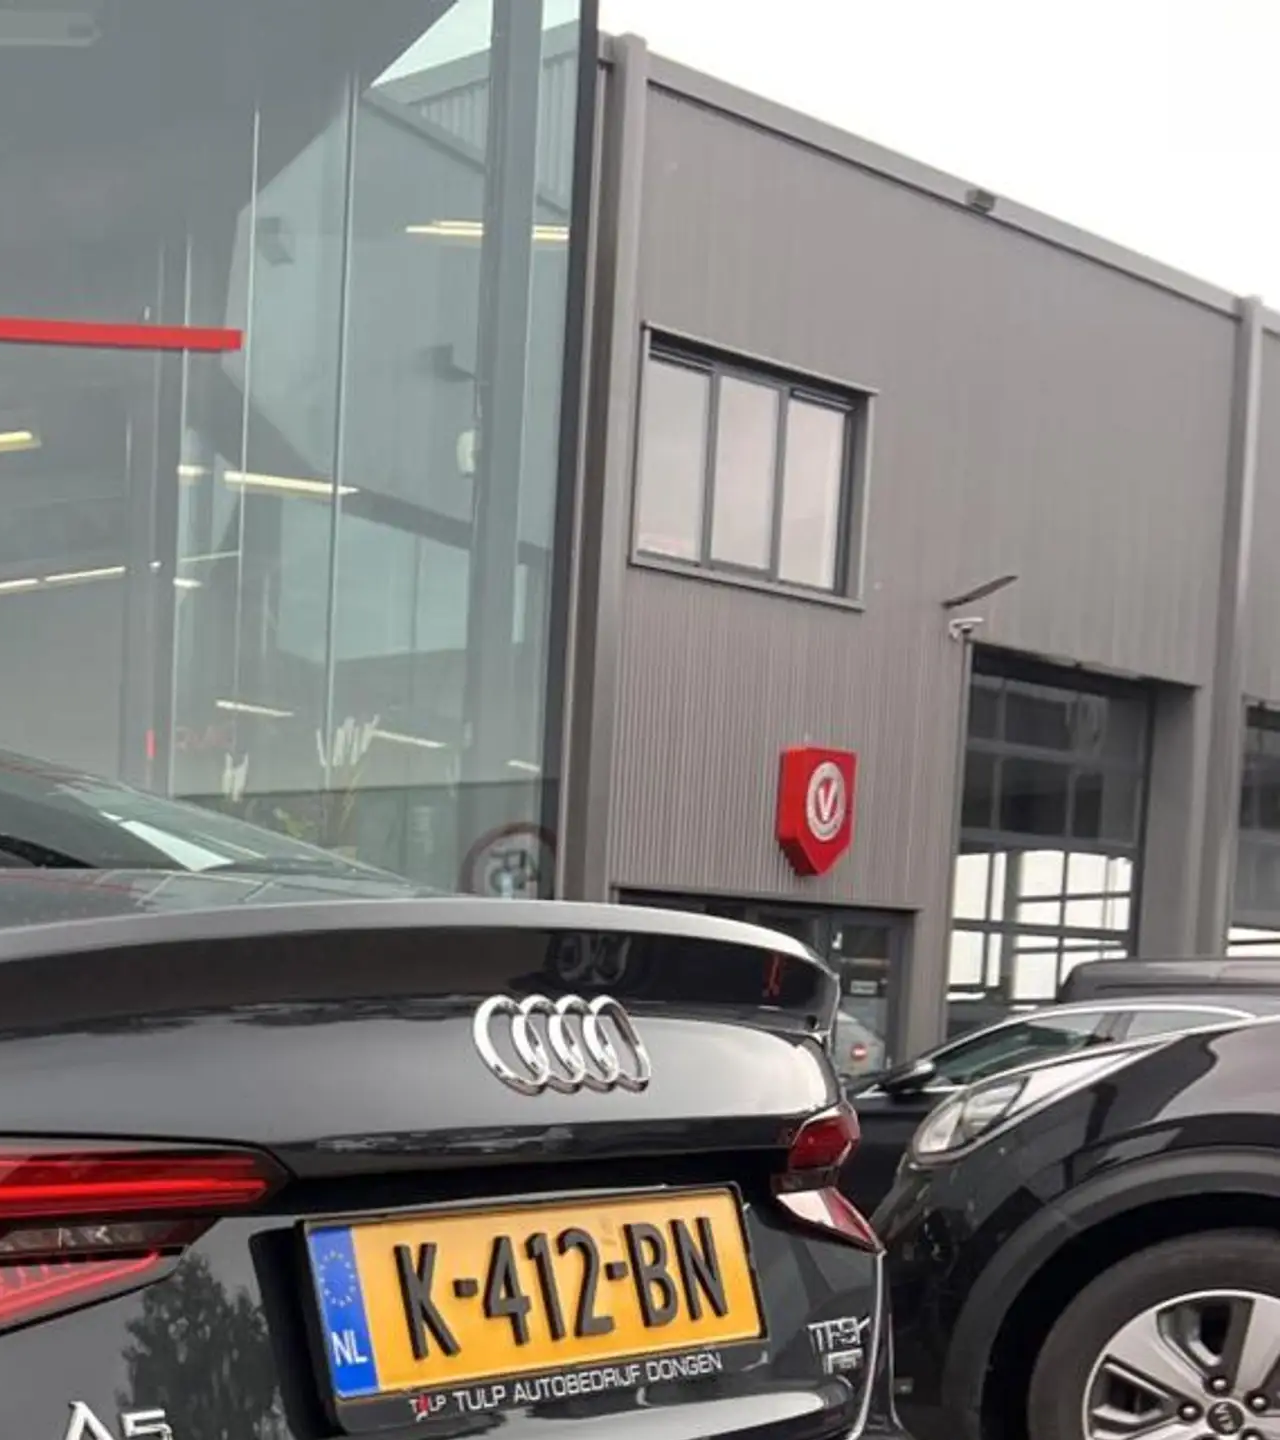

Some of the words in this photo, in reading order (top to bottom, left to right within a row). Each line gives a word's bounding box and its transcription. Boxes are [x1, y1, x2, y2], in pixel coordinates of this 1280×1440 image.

[393, 1216, 728, 1361] K-412-BN
[332, 1330, 368, 1366] NL
[452, 1385, 505, 1412] TULP
[513, 1363, 640, 1403] AUTOBEDRIJF
[646, 1351, 723, 1381] DONGEN
